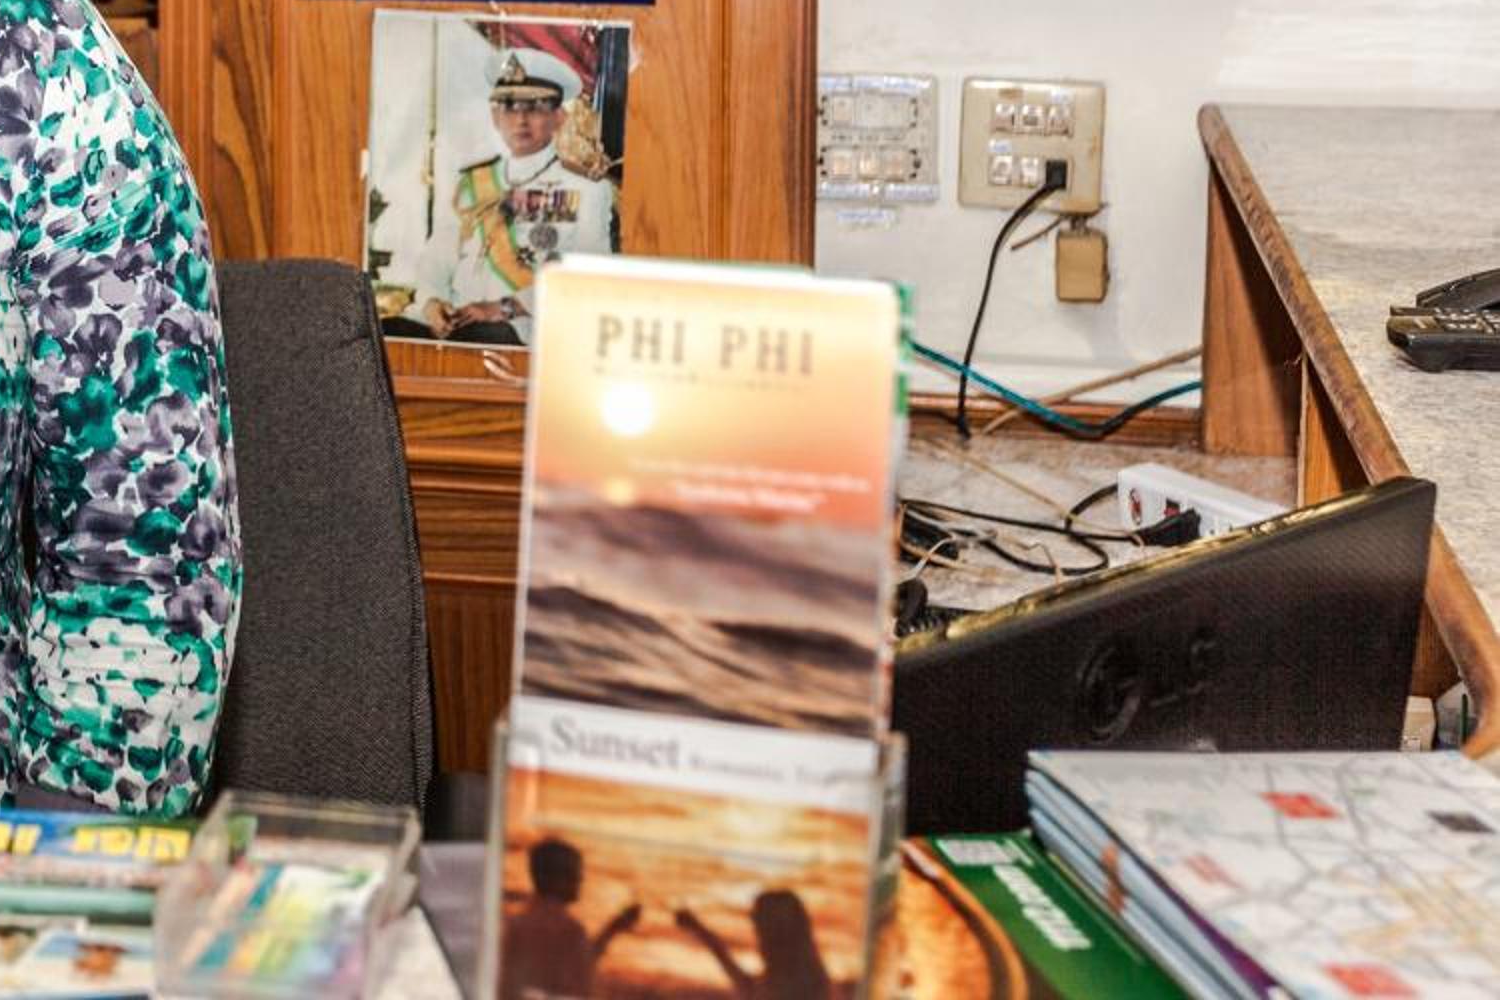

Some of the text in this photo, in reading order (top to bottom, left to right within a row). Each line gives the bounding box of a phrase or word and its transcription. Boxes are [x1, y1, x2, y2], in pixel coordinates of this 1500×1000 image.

[596, 313, 813, 376] PHI PHI
[550, 713, 682, 770] Sunset
